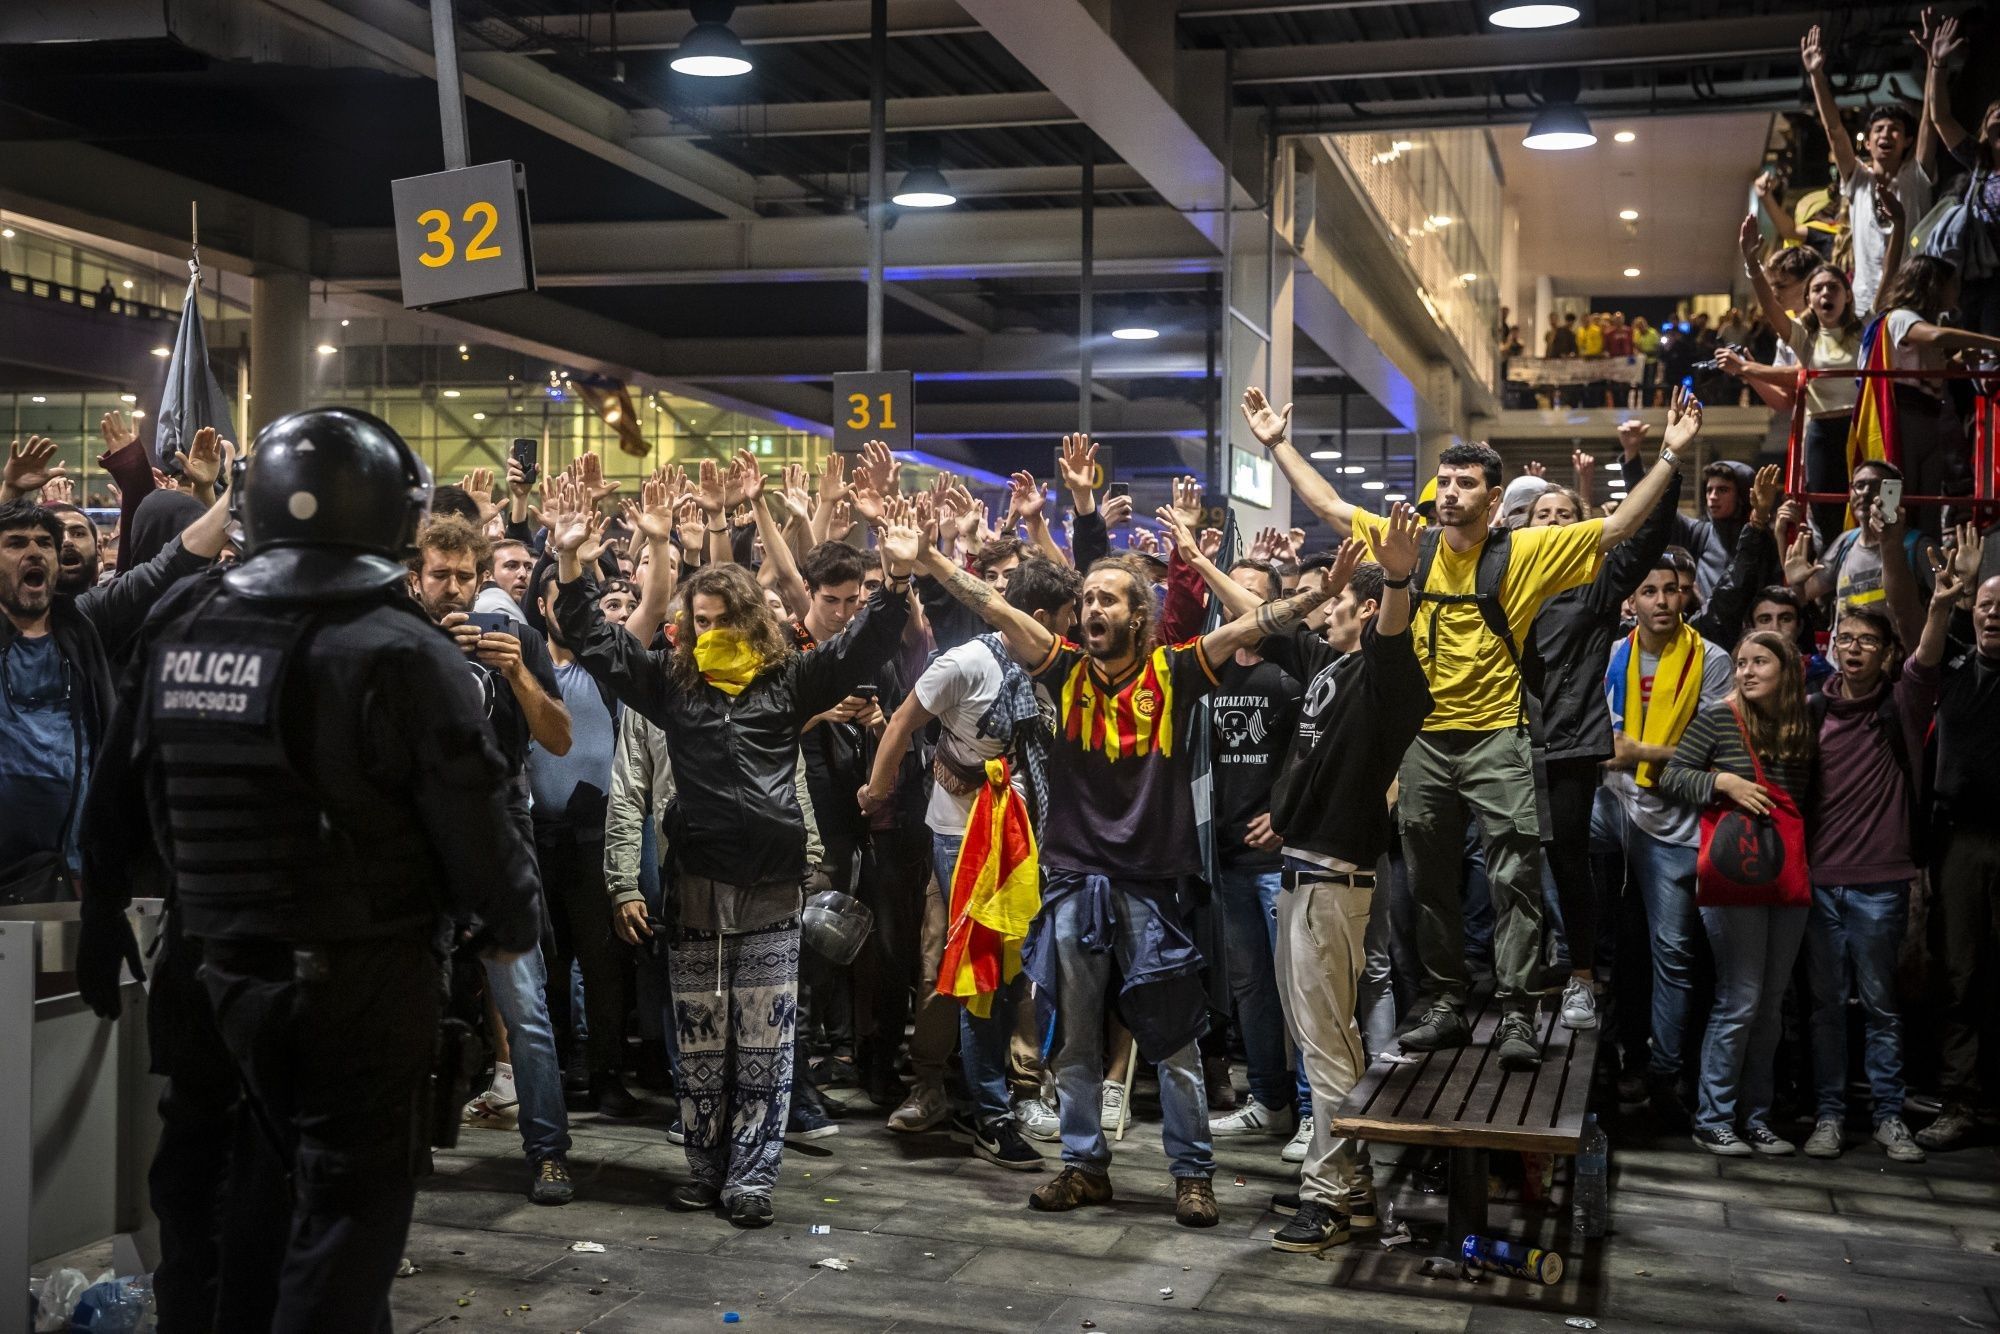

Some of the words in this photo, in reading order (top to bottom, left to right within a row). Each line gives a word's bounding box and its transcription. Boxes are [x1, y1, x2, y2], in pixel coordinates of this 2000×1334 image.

[416, 201, 502, 268] 32
[846, 393, 897, 430] 31
[161, 651, 262, 687] POLICIA
[1213, 695, 1269, 708] CATALUNYA
[1233, 754, 1240, 763] O
[1242, 753, 1269, 764] MORT
